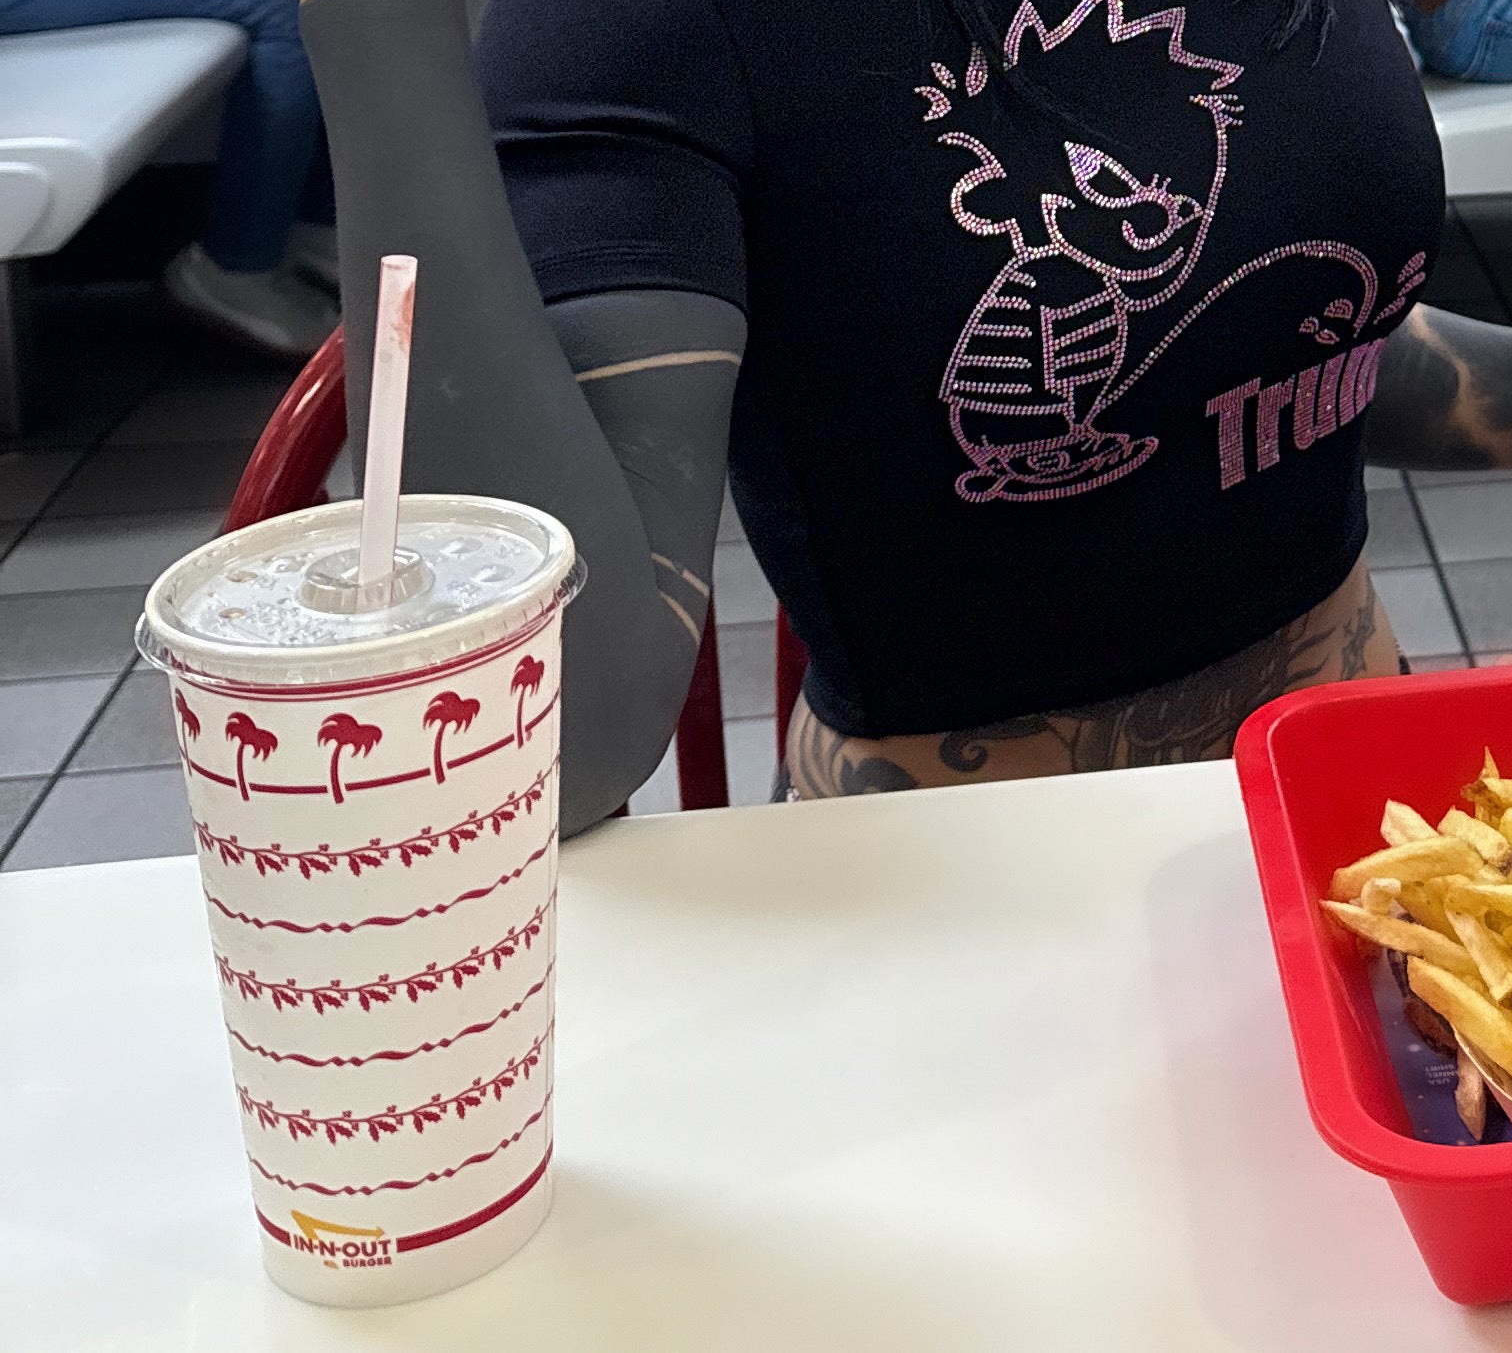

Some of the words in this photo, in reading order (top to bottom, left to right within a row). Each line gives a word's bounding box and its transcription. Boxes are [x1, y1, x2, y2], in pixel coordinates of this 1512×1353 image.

[1206, 337, 1389, 490] Trum
[293, 1233, 392, 1258] IN-N-OUT
[342, 1256, 393, 1268] BURGER
